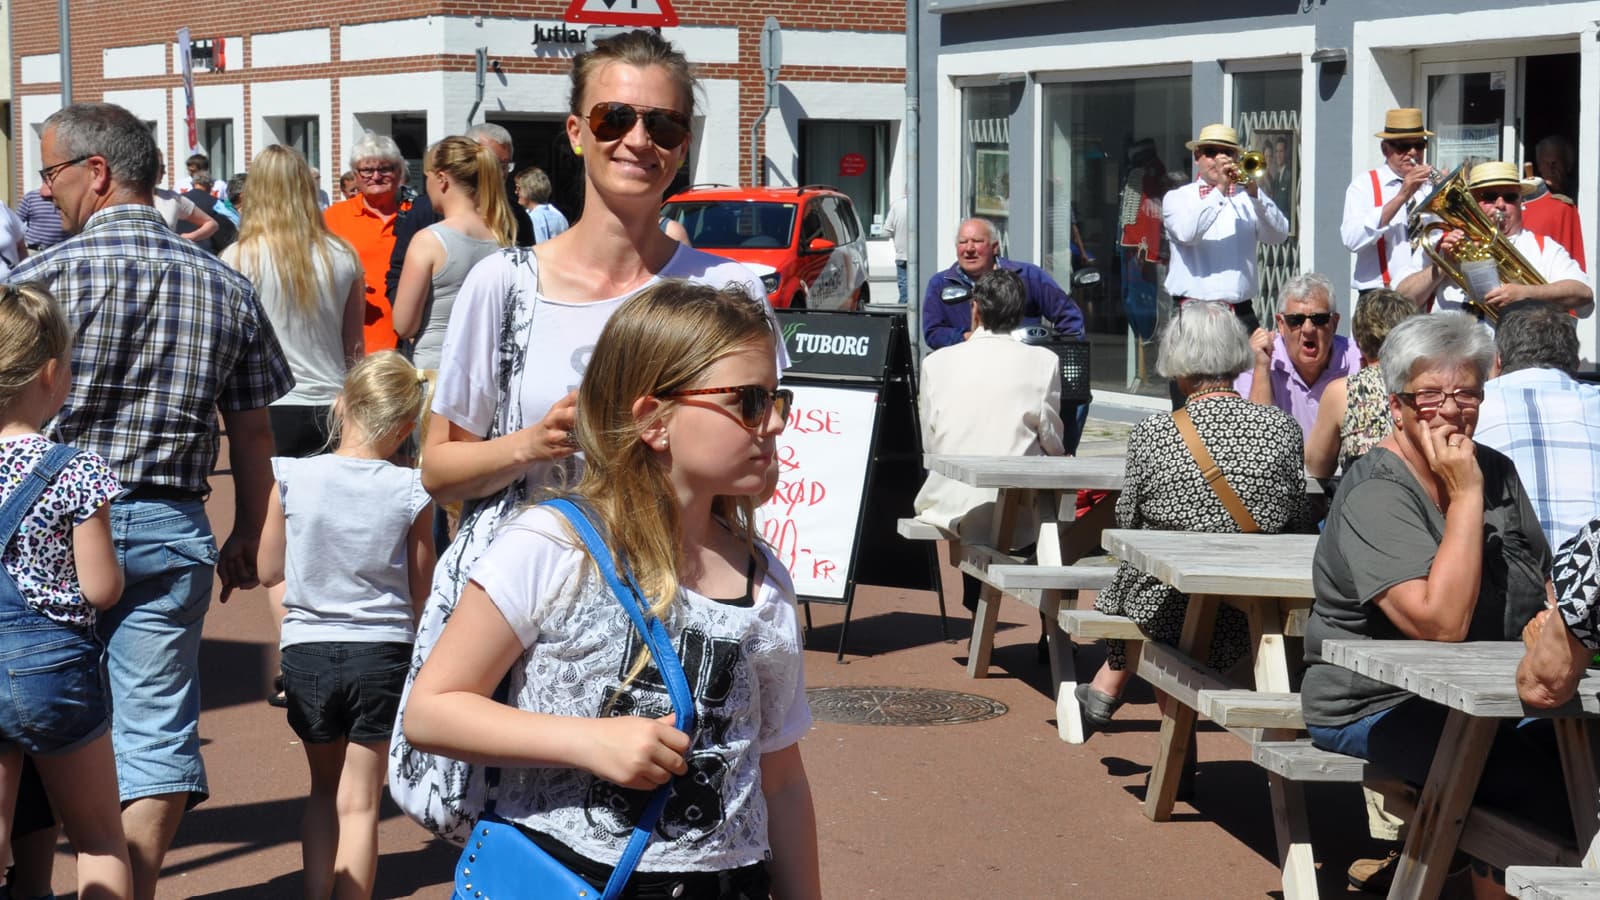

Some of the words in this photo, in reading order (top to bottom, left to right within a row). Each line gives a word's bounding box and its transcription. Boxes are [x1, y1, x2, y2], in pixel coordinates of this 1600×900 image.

[795, 333, 869, 356] TUBORG
[787, 408, 842, 435] LSE
[764, 478, 826, 516] RØD
